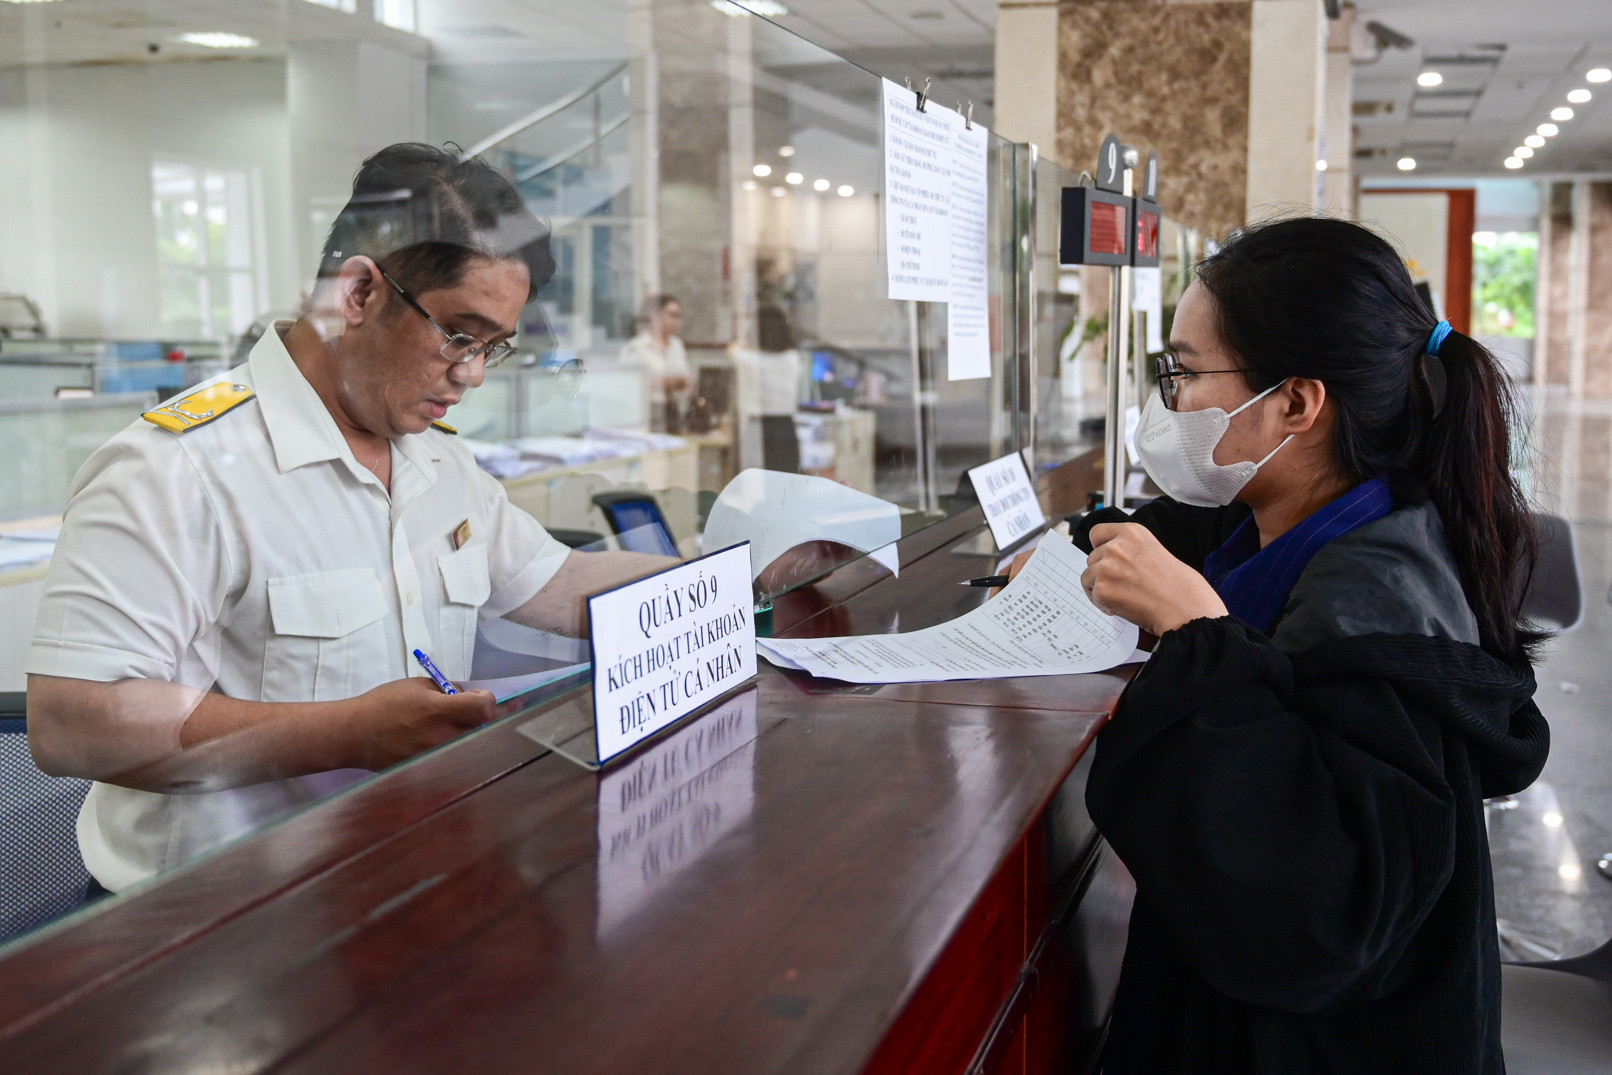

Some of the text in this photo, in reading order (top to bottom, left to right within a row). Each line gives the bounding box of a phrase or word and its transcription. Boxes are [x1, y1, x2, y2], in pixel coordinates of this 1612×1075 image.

[1107, 142, 1117, 184] 9
[639, 571, 718, 639] QUẦY SỐ 9
[607, 603, 746, 693] KÍCH HOẠT TÀI KHOẢN
[619, 690, 656, 735] ĐIỆN
[659, 669, 682, 711] TỬ
[684, 657, 703, 698] CÁ
[706, 642, 742, 688] NHÂN
